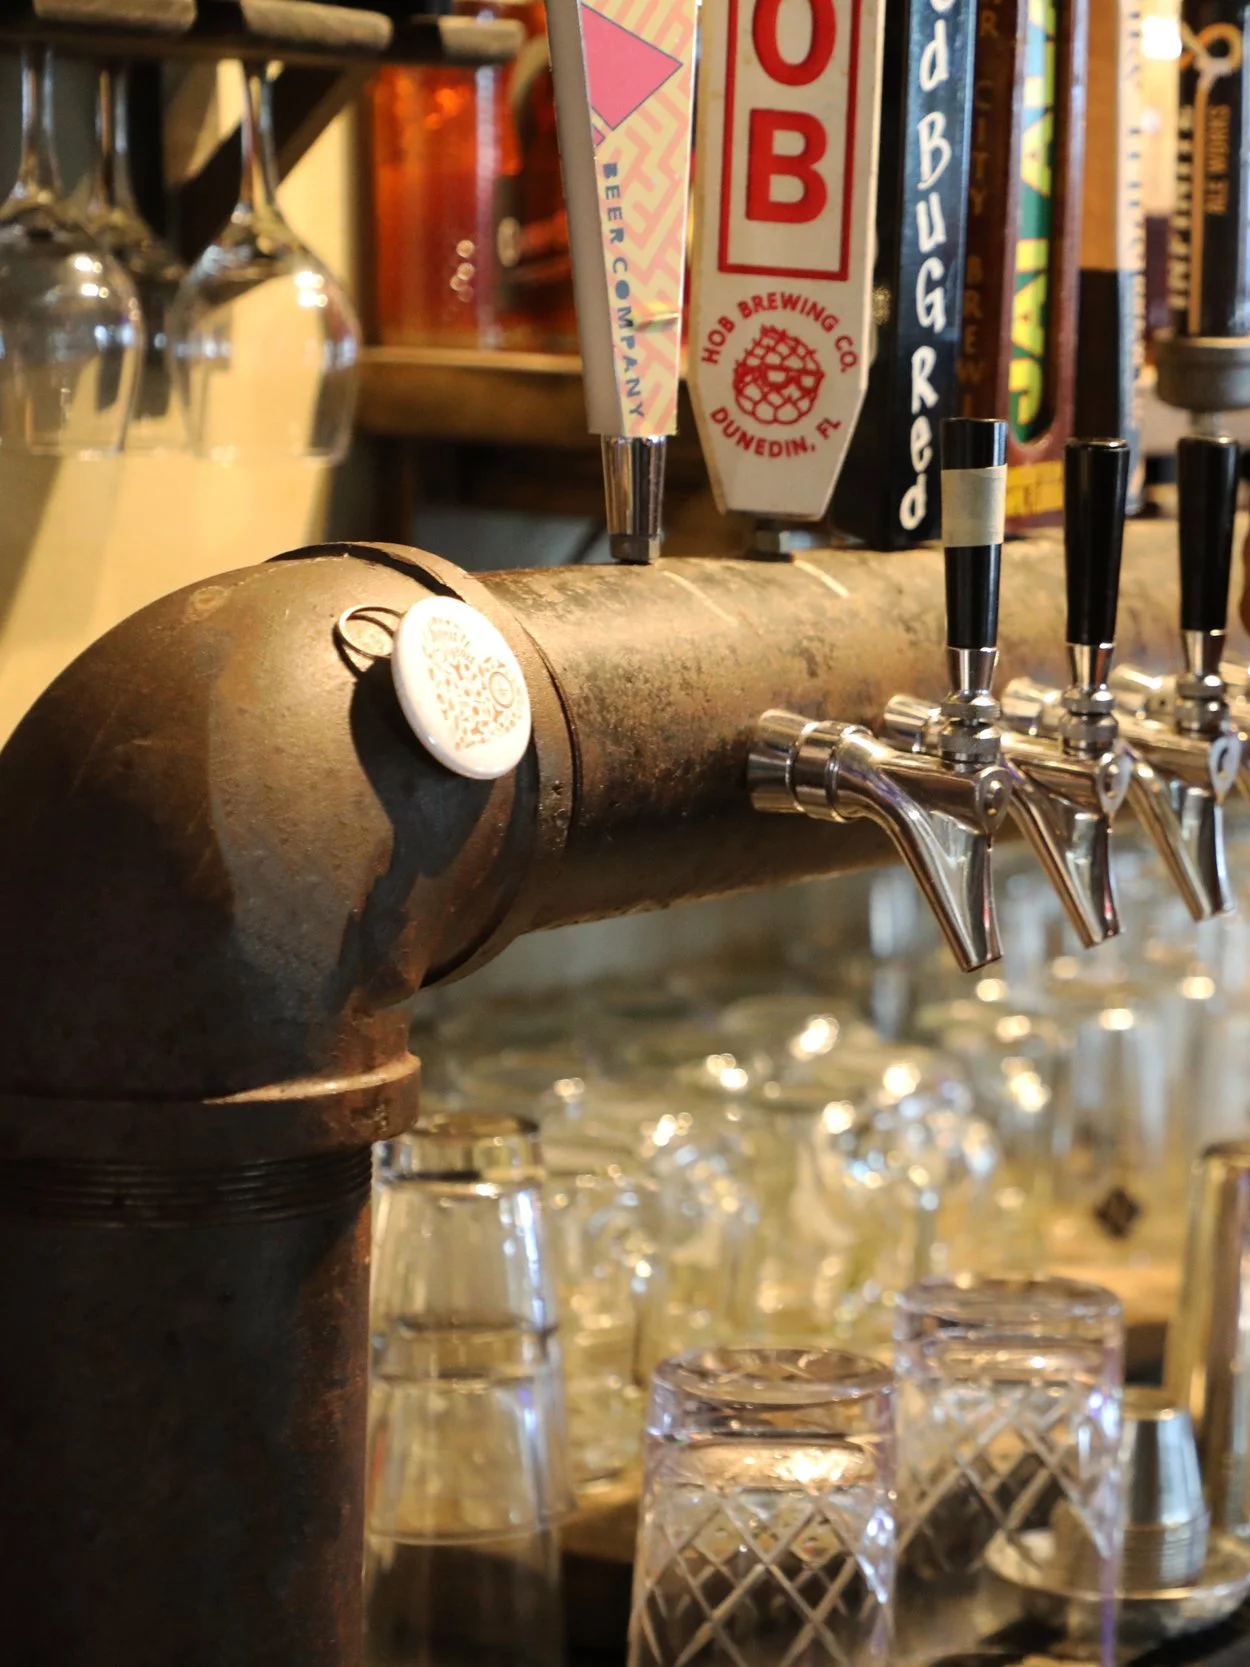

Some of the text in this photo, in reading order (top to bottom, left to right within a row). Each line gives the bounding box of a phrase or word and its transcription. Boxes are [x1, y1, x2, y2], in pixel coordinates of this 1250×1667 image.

[603, 162, 645, 418] BEER COMPANY
[701, 291, 859, 374] HOB BREWING CO.
[815, 416, 842, 440] FL
